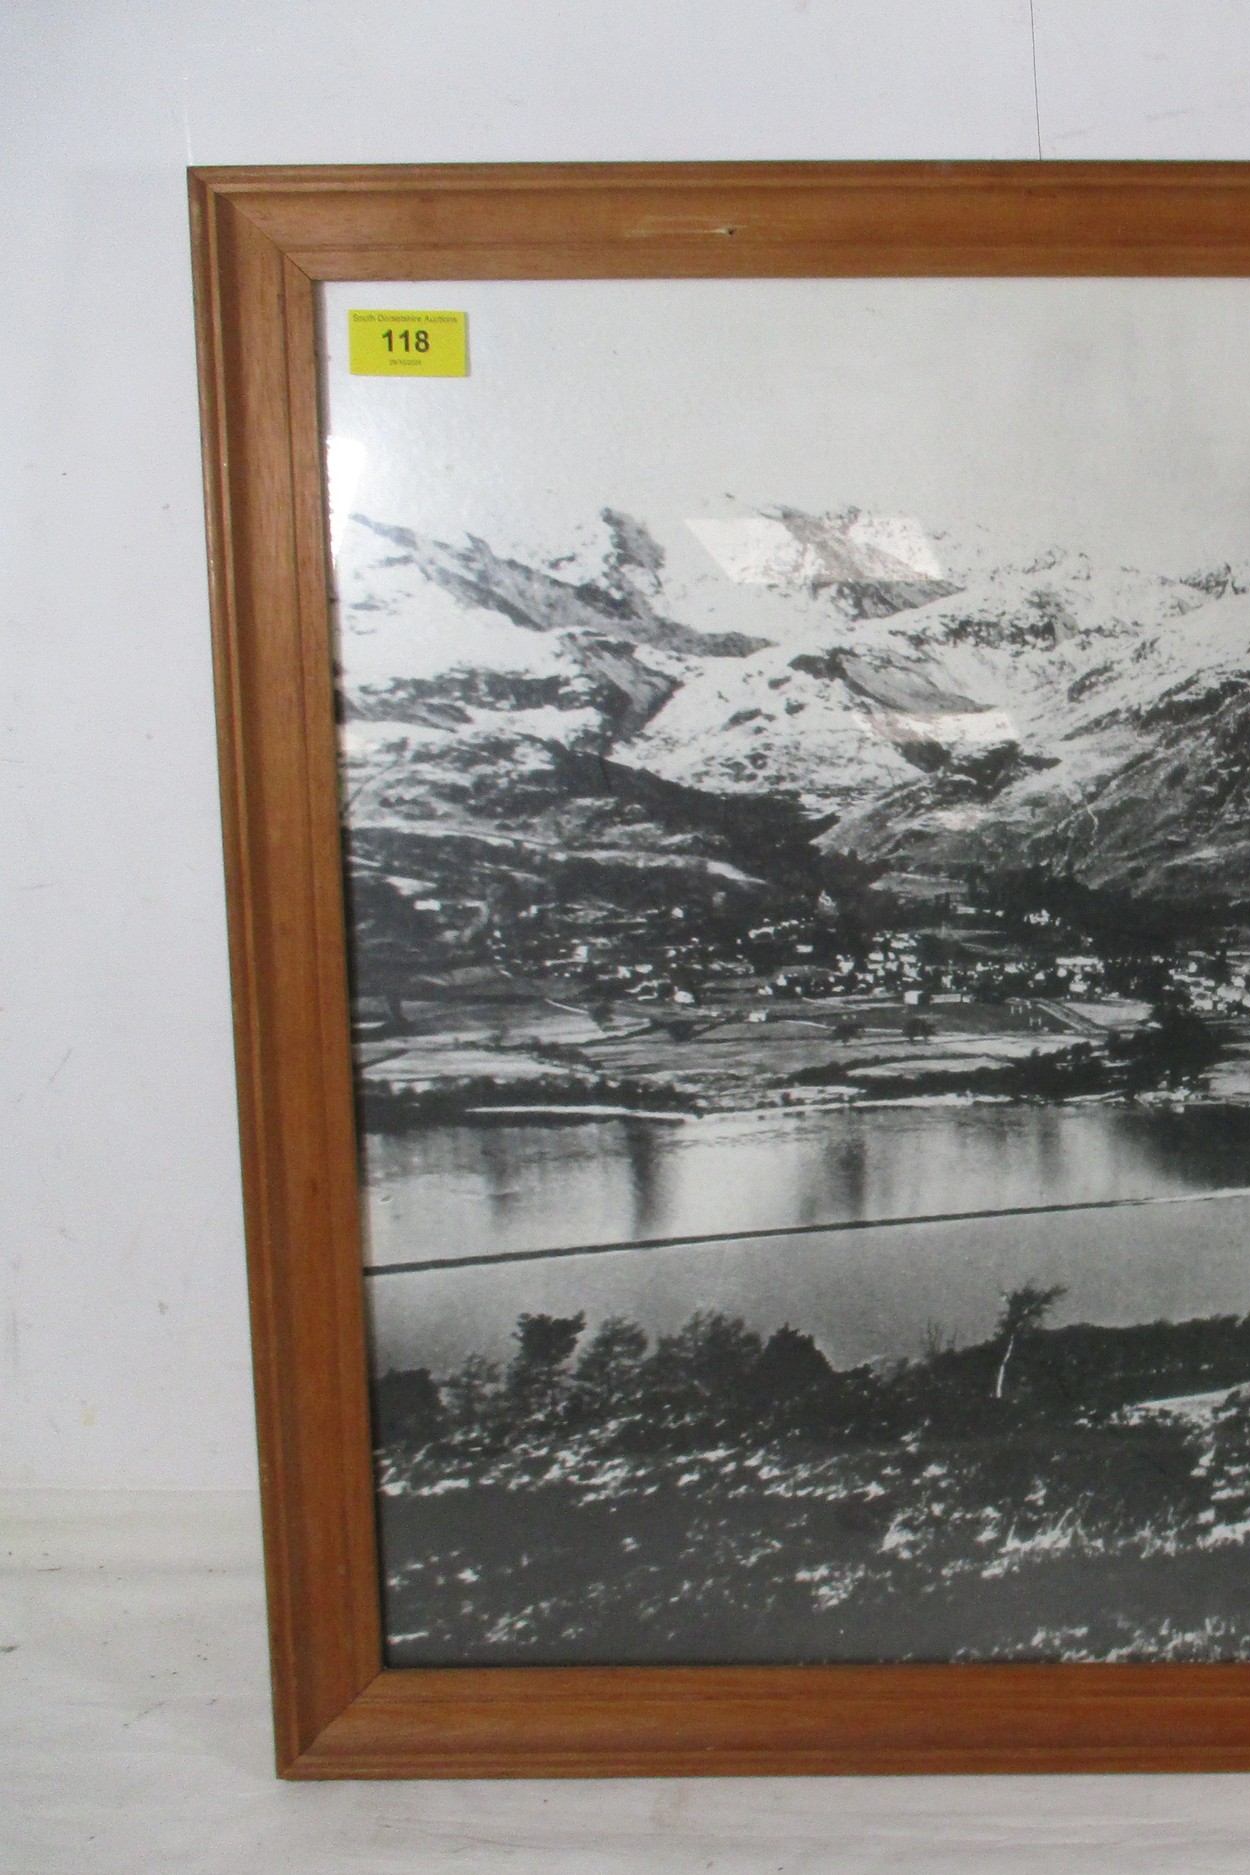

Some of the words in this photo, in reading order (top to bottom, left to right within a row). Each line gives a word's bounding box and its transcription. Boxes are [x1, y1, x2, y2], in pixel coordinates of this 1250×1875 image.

[353, 313, 377, 322] South
[425, 314, 458, 323] Auctions
[382, 329, 430, 353] 118
